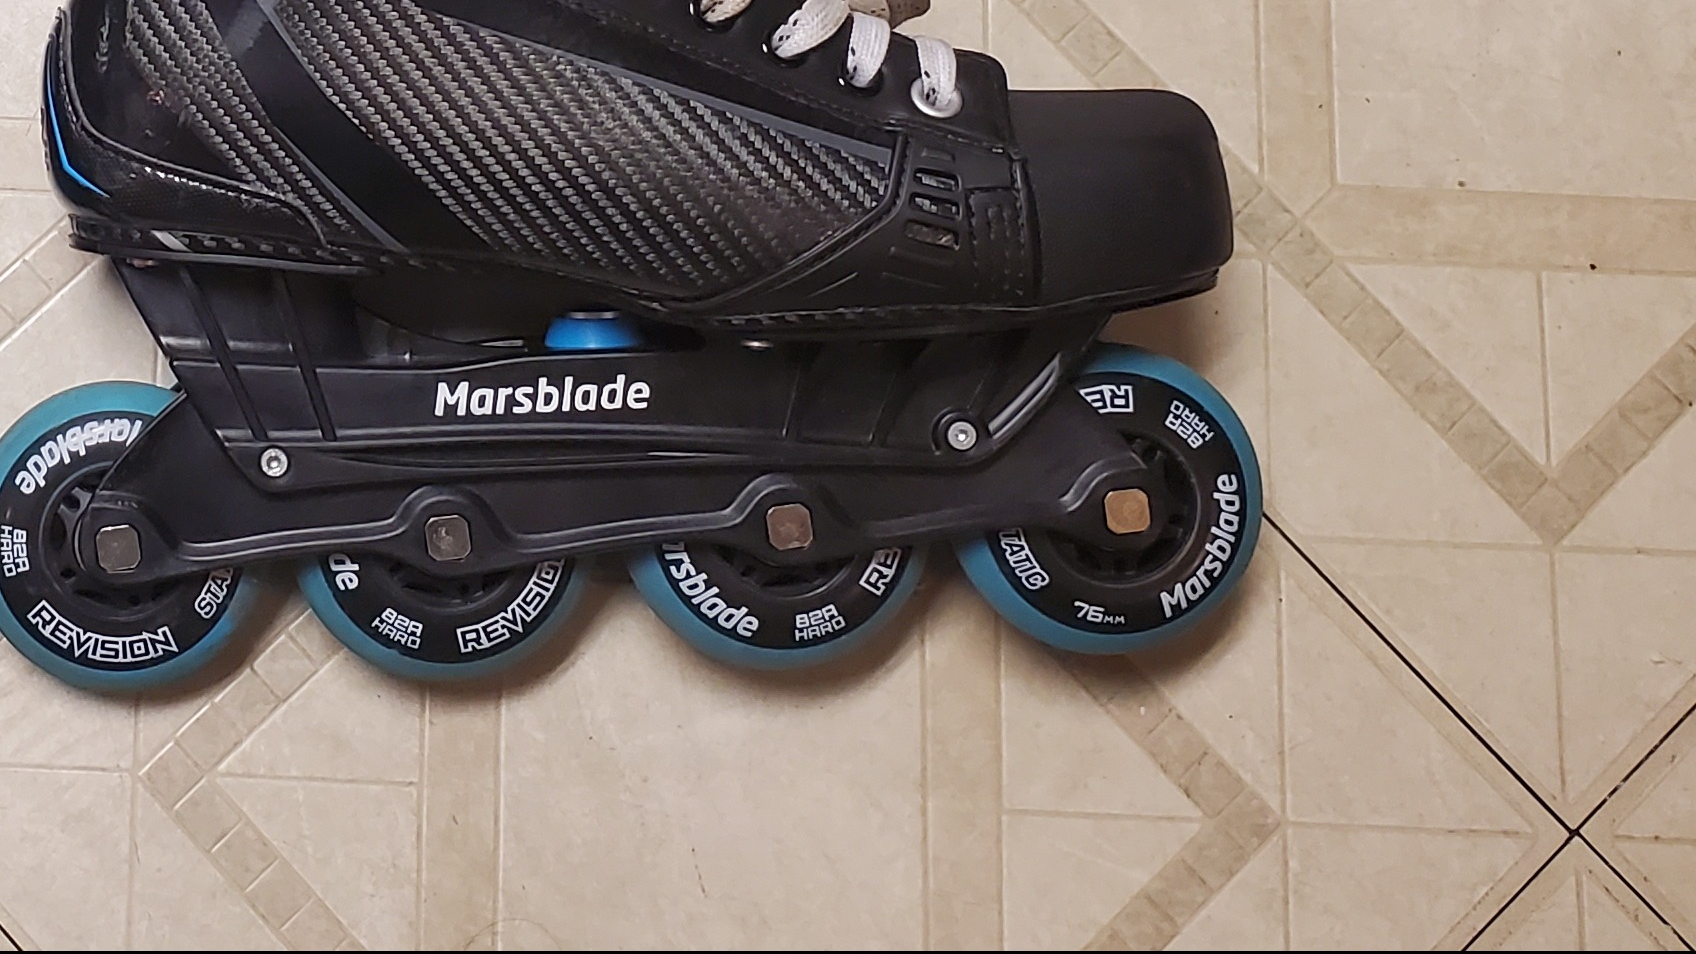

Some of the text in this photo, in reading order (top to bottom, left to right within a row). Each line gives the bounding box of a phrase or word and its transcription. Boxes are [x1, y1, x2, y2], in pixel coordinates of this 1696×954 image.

[434, 374, 651, 417] Marsblade
[1164, 413, 1204, 449] 82A
[1170, 400, 1215, 442] HARD
[0, 525, 17, 578] HARD
[13, 528, 30, 573] 82A
[1159, 473, 1241, 619] Marsblade
[194, 567, 234, 619] STA
[456, 558, 565, 653] REVISIO
[26, 599, 179, 663] REVISION
[371, 616, 421, 649] HARD
[380, 607, 424, 638] 82A
[794, 615, 846, 642] HARD
[795, 603, 838, 629] 82A
